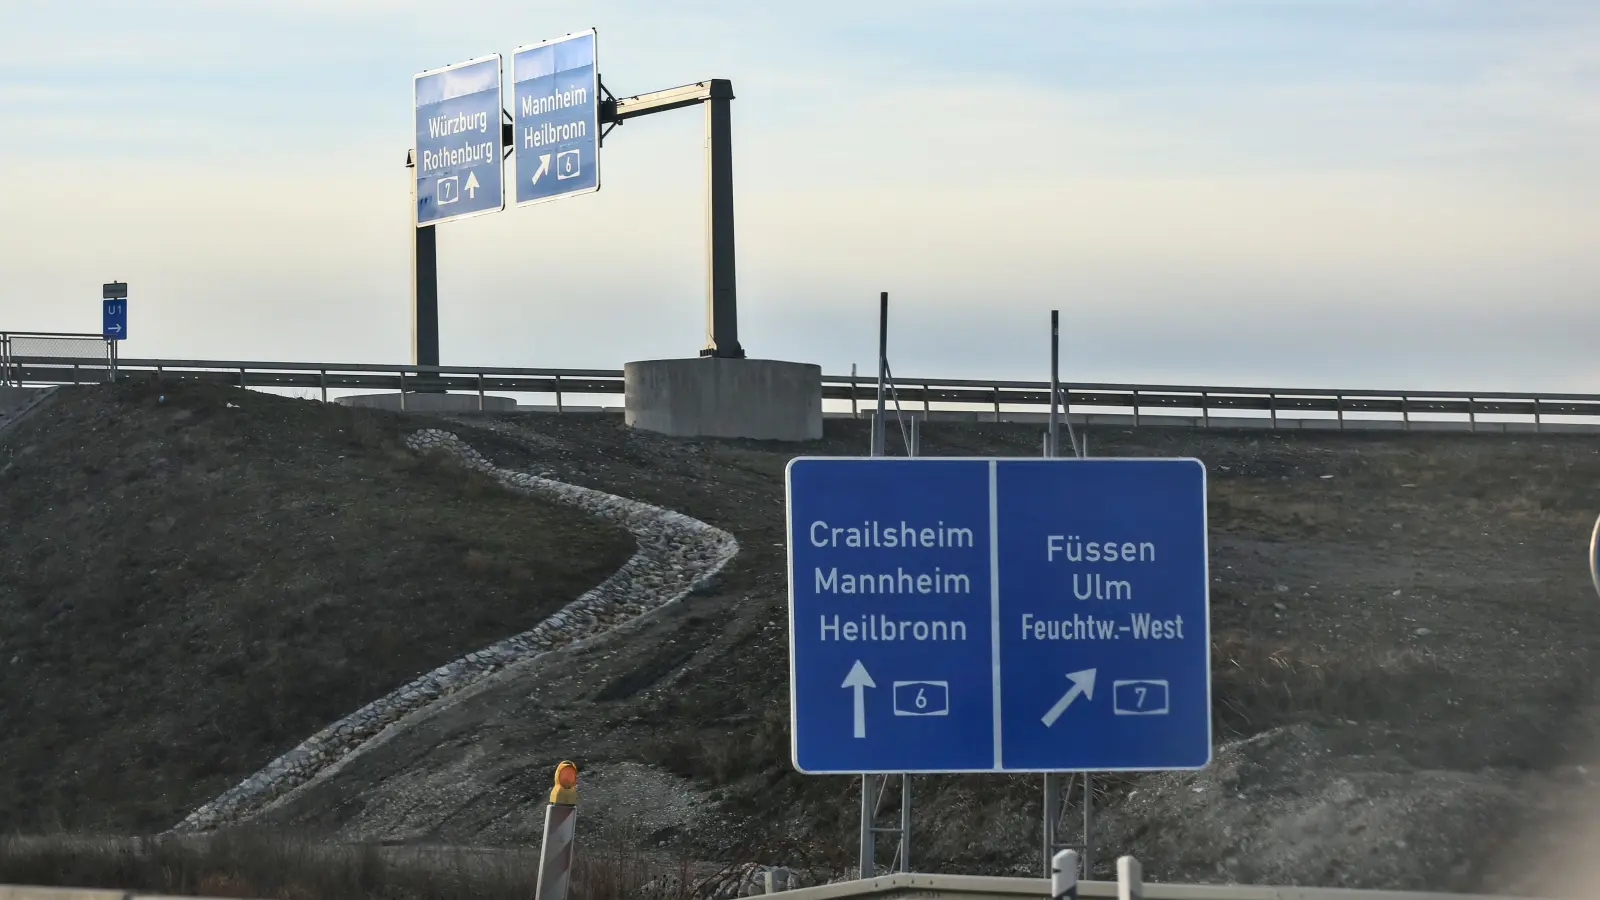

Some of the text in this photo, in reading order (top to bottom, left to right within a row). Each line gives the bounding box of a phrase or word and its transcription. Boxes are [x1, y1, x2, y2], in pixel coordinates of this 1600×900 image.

[522, 85, 587, 117] Mannheim
[429, 111, 487, 138] Würzburg
[524, 120, 585, 149] Heilbronn
[423, 141, 493, 171] Rothenburg
[565, 157, 572, 173] 6
[444, 182, 451, 198] 7
[810, 520, 974, 548] Crailsheim
[1047, 535, 1156, 562] Füssen
[814, 567, 970, 594] Mannheim
[1073, 573, 1132, 600] Ulm
[820, 614, 967, 641] Heilbronn
[1021, 612, 1185, 640] Feuchtw.-West
[915, 688, 927, 709] 6
[1135, 687, 1147, 708] 7
